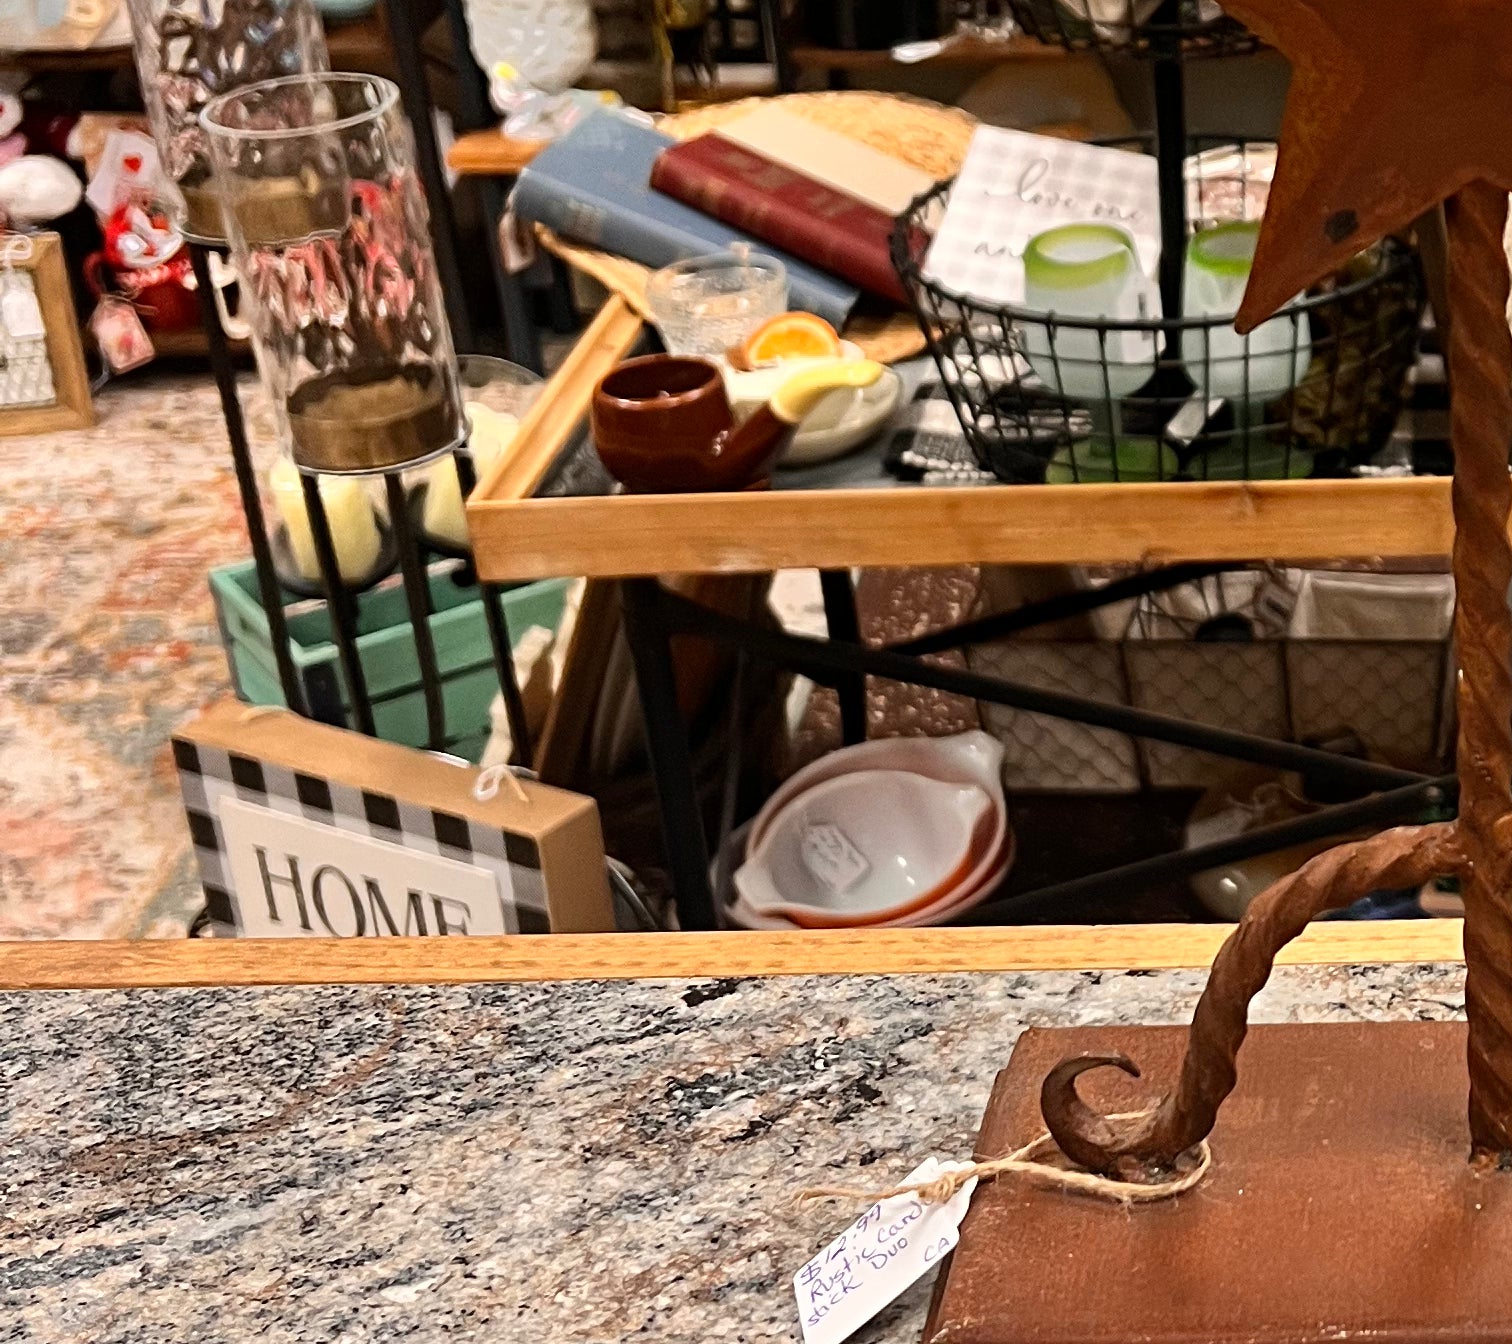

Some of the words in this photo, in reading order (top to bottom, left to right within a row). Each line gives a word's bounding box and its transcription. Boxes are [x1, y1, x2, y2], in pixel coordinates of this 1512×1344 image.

[984, 158, 1075, 204] love
[252, 844, 472, 938] HOME
[800, 1203, 882, 1286] $12.99
[924, 1236, 950, 1263] CA
[807, 1275, 864, 1328] stick
[810, 1246, 876, 1303] Rustic
